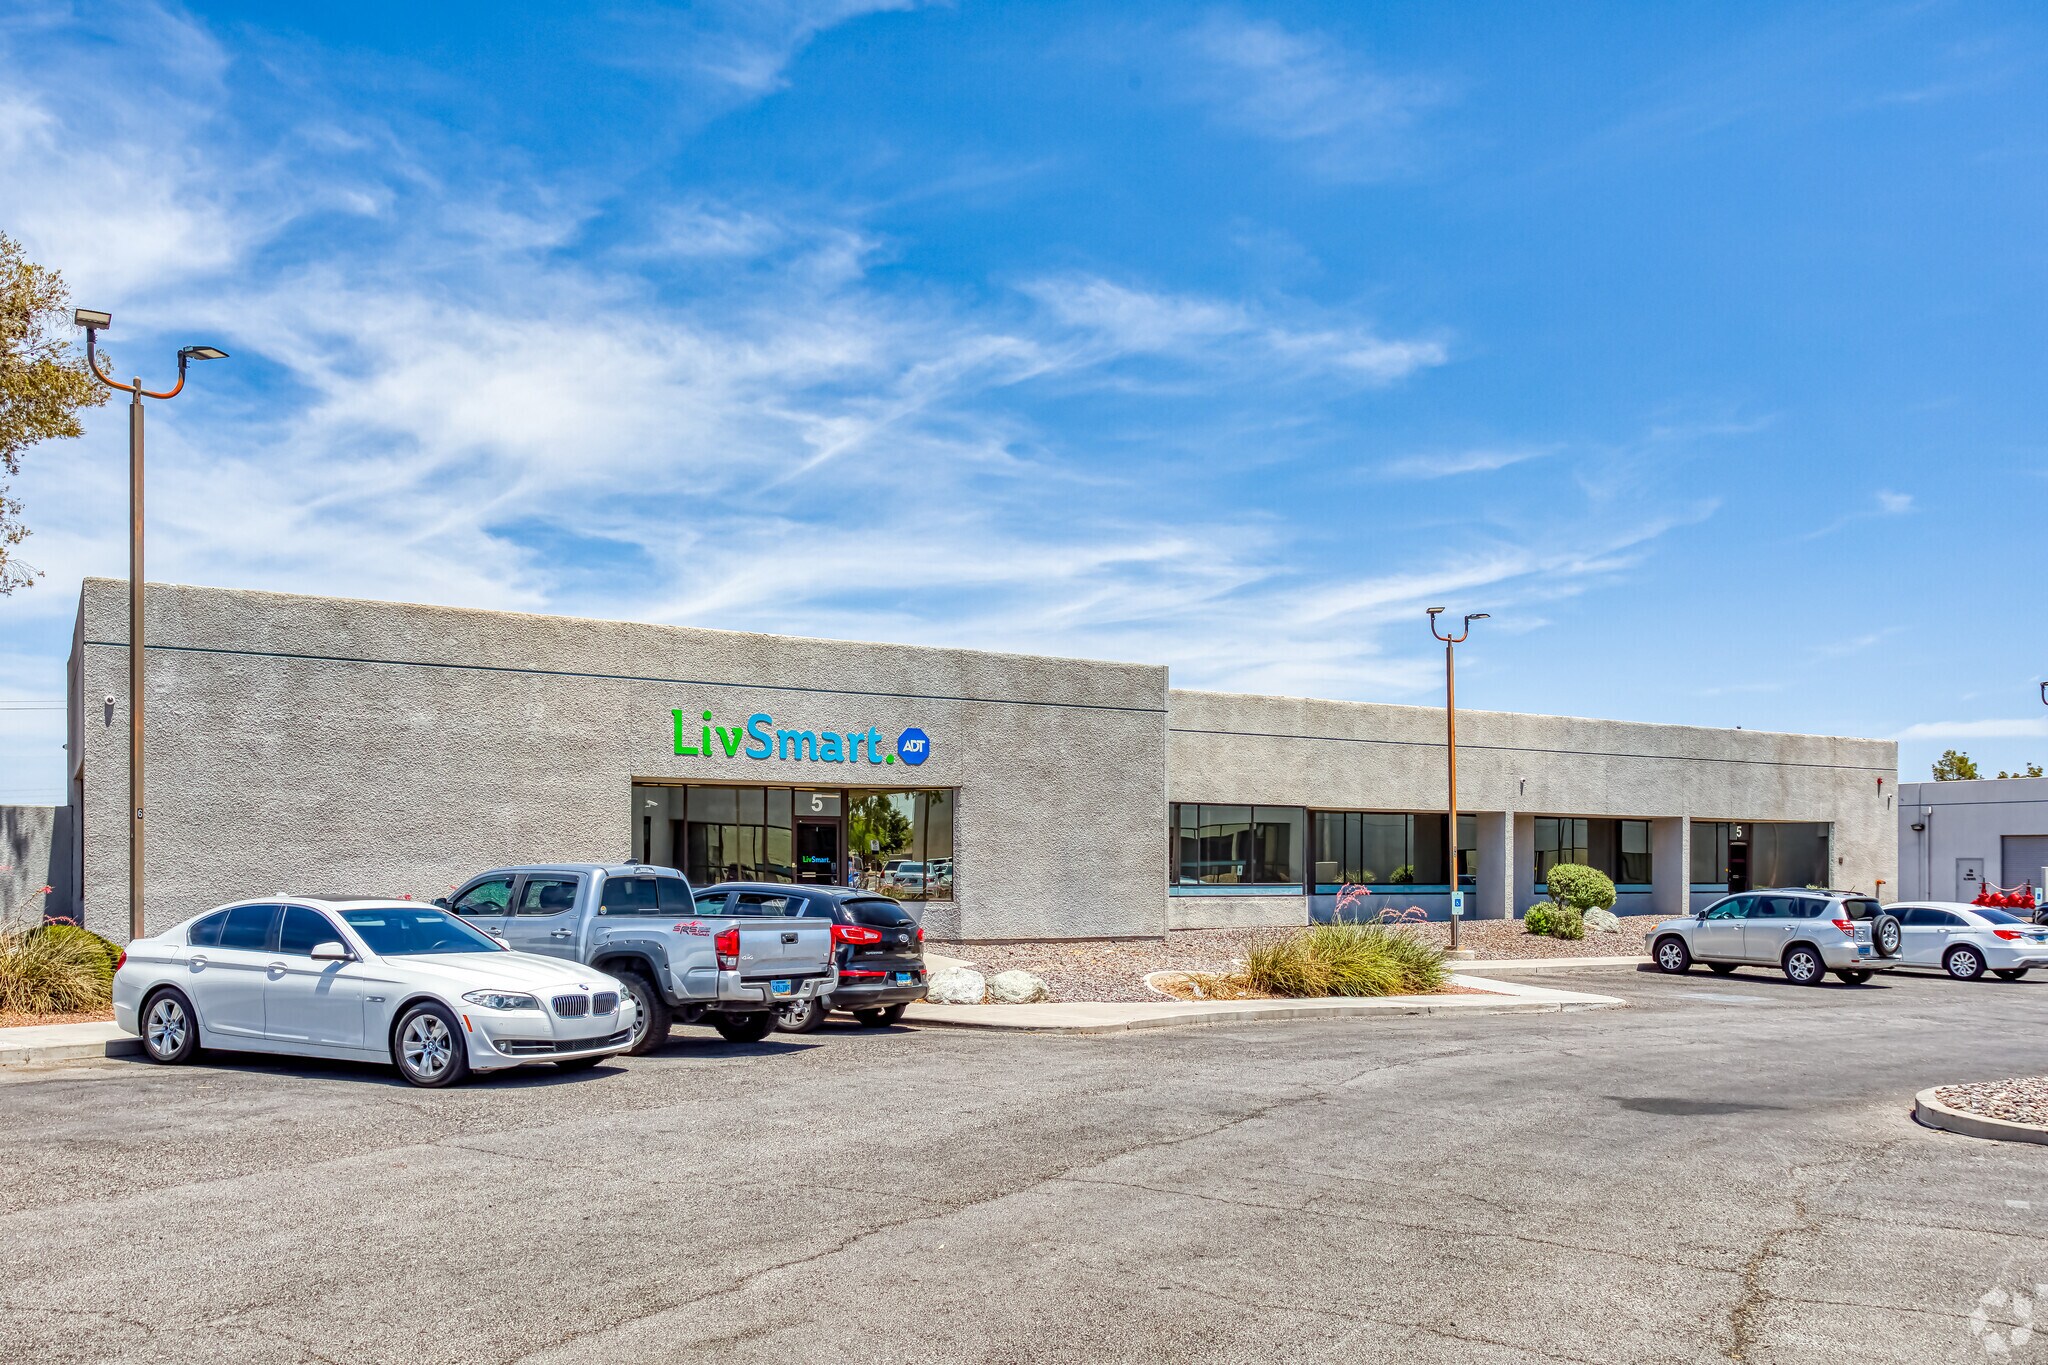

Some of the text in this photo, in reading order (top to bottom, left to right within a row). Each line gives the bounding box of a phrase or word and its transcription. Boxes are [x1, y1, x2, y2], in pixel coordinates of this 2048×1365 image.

[671, 709, 895, 765] LivSmart.
[902, 739, 926, 753] ADT
[811, 794, 824, 812] 5
[1736, 825, 1742, 837] 5
